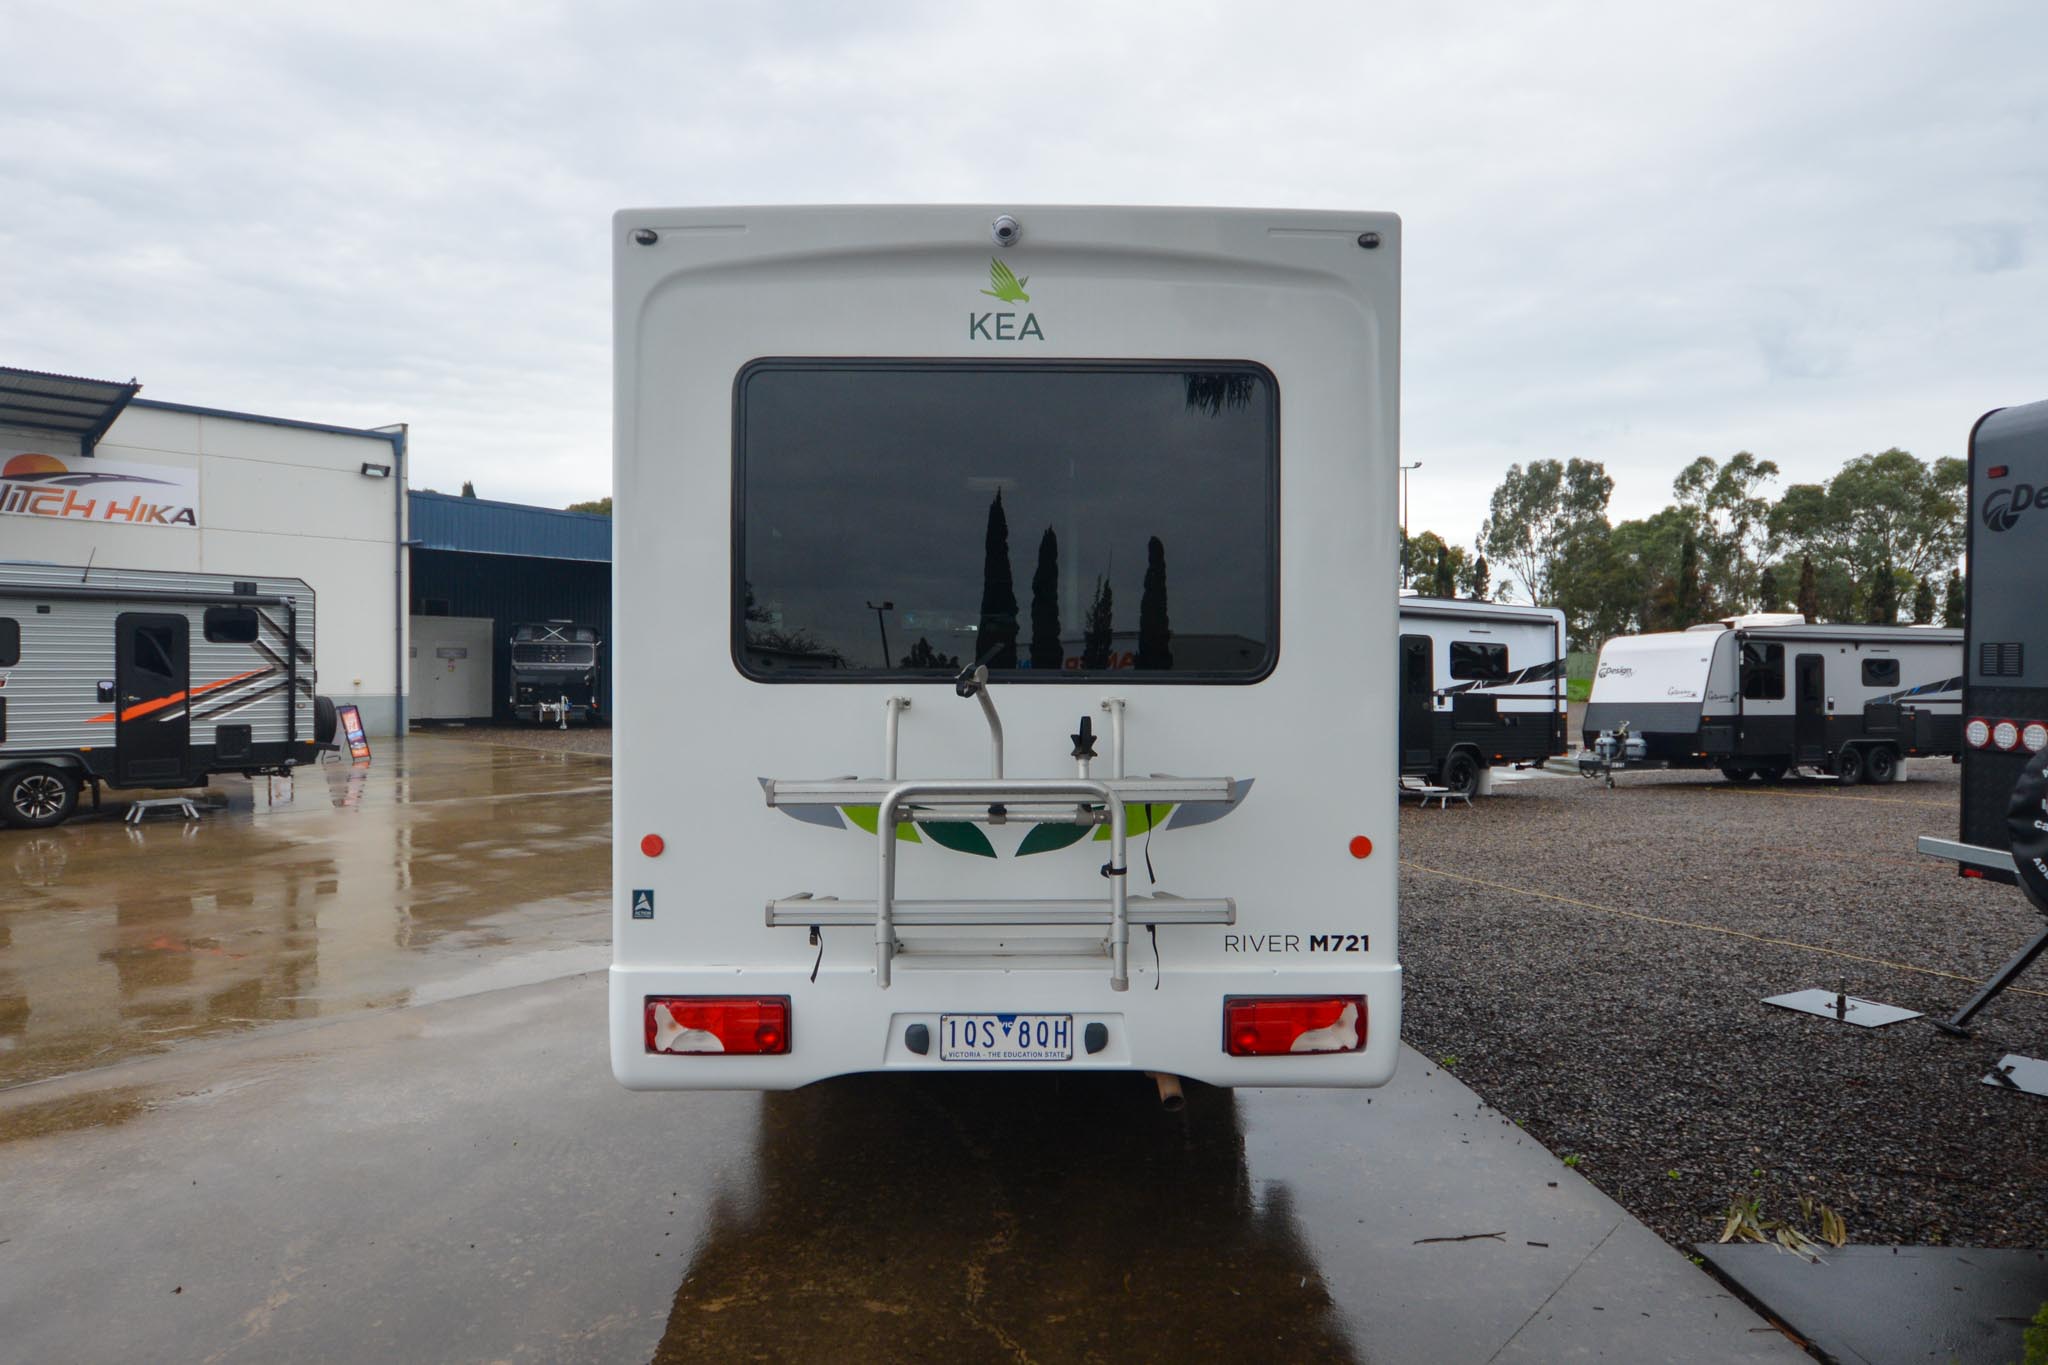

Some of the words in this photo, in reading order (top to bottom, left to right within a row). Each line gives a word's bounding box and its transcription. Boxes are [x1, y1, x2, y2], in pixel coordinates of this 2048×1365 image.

[969, 312, 1045, 340] KEA
[104, 495, 197, 526] HIKA
[1225, 935, 1300, 952] RIVER
[1310, 935, 1369, 952] M721
